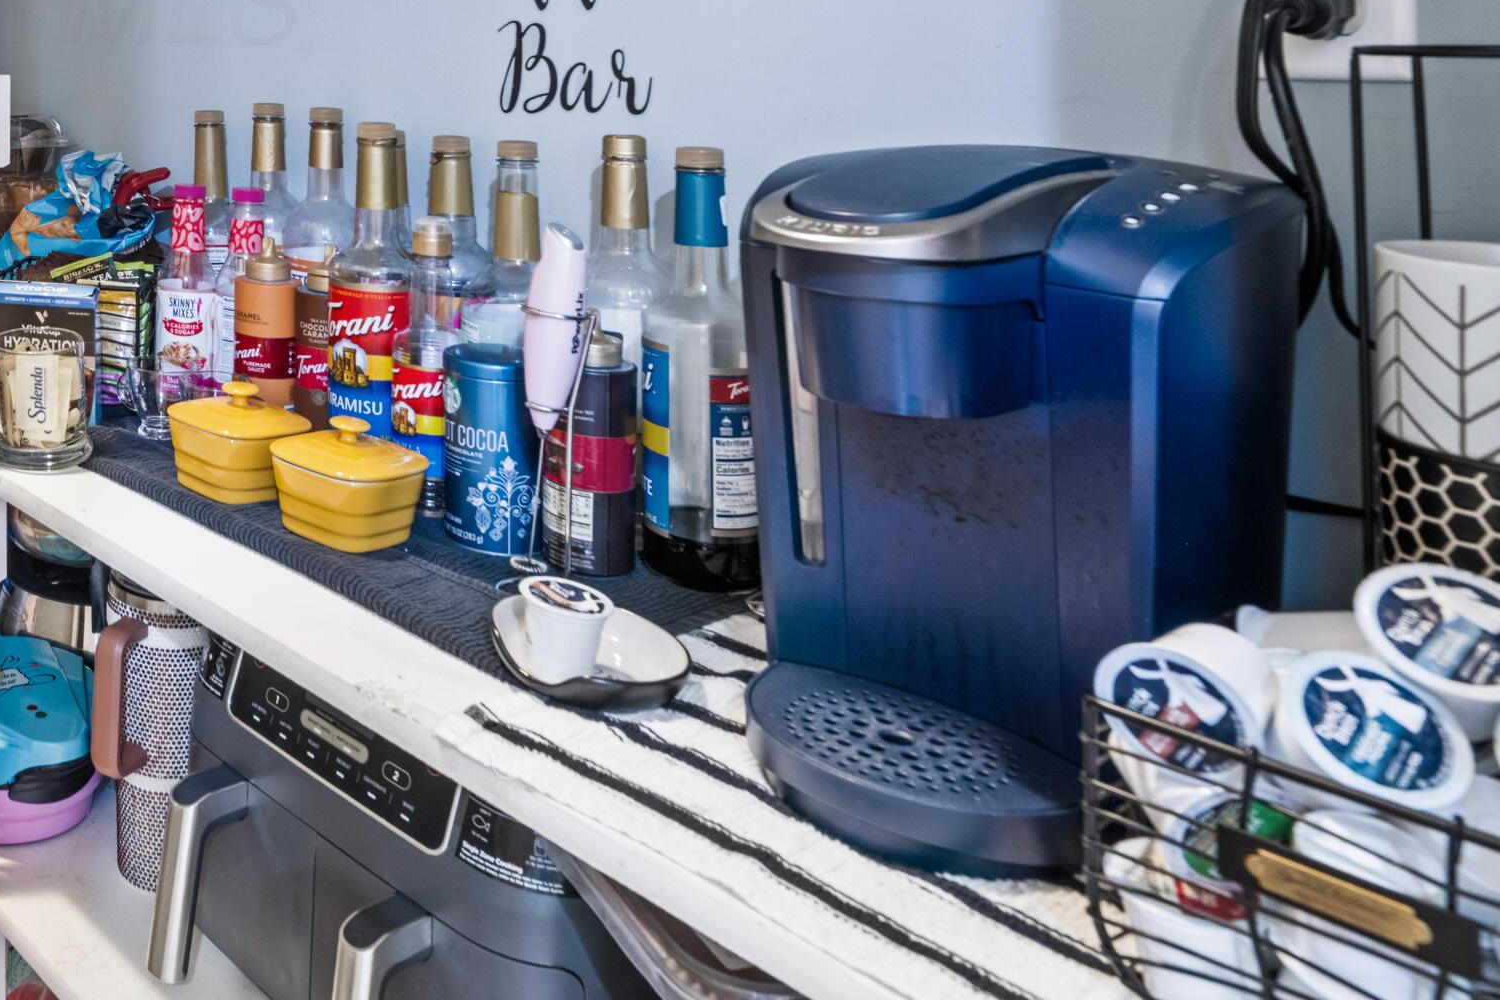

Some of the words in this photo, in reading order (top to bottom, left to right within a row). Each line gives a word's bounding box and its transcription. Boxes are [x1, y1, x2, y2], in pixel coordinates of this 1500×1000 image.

[497, 20, 653, 115] Bar
[15, 285, 69, 294] VitaCup
[169, 296, 196, 309] SKINNY
[173, 306, 195, 318] MIXES
[236, 311, 261, 321] ARAMEL
[21, 324, 61, 336] VitaCup
[170, 322, 200, 331] CALORIES
[174, 328, 195, 336] SUGAR
[4, 336, 85, 354] HYDRATION
[243, 360, 271, 370] PUREMADE
[248, 366, 265, 374] SAUCE
[392, 368, 444, 400] rani
[28, 366, 45, 424] Splenda
[328, 393, 383, 416] IRAMISU
[457, 424, 509, 453] COCOA
[715, 466, 750, 474] Calories
[275, 694, 280, 705] 1
[392, 770, 400, 782] 2
[462, 840, 480, 855] Single
[479, 849, 495, 863] Zone
[495, 857, 524, 876] Cooking
